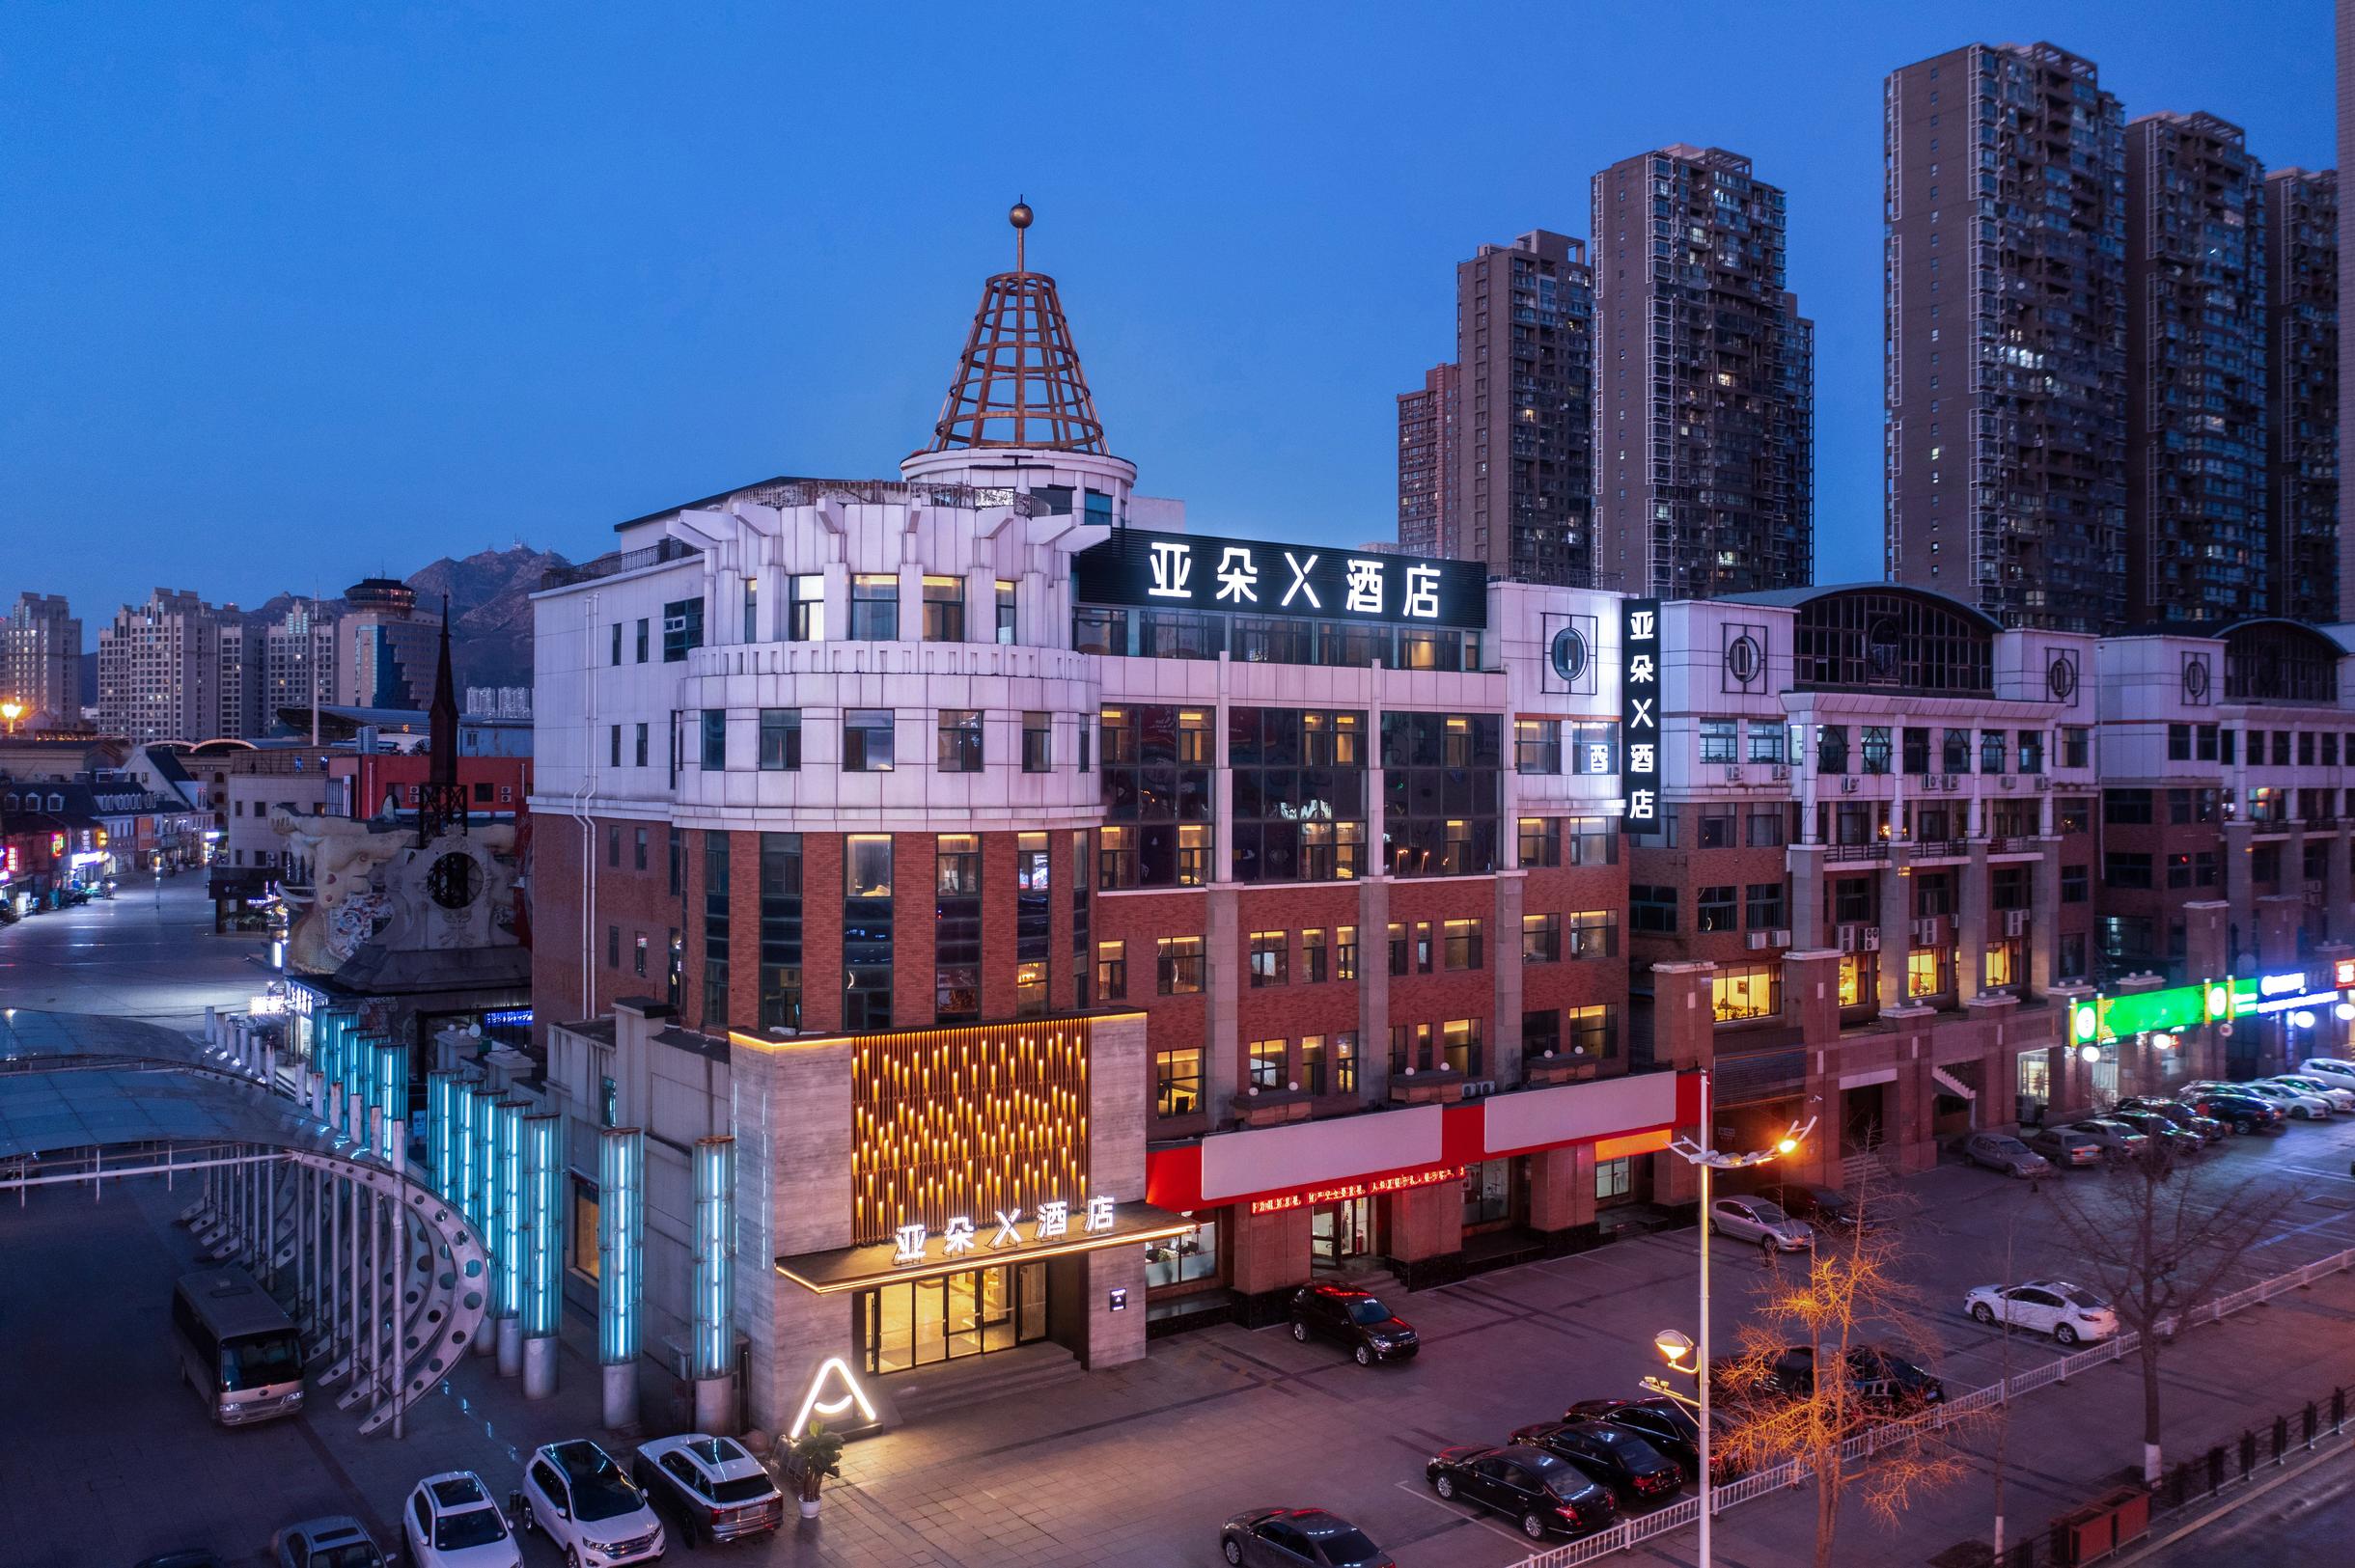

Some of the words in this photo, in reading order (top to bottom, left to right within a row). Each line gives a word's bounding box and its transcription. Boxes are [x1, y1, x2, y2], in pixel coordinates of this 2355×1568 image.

[1148, 541, 1441, 619] 亚朵X酒店
[1629, 611, 1654, 819] 亚朵X酒店
[894, 1195, 1116, 1263] 亚朵X酒店
